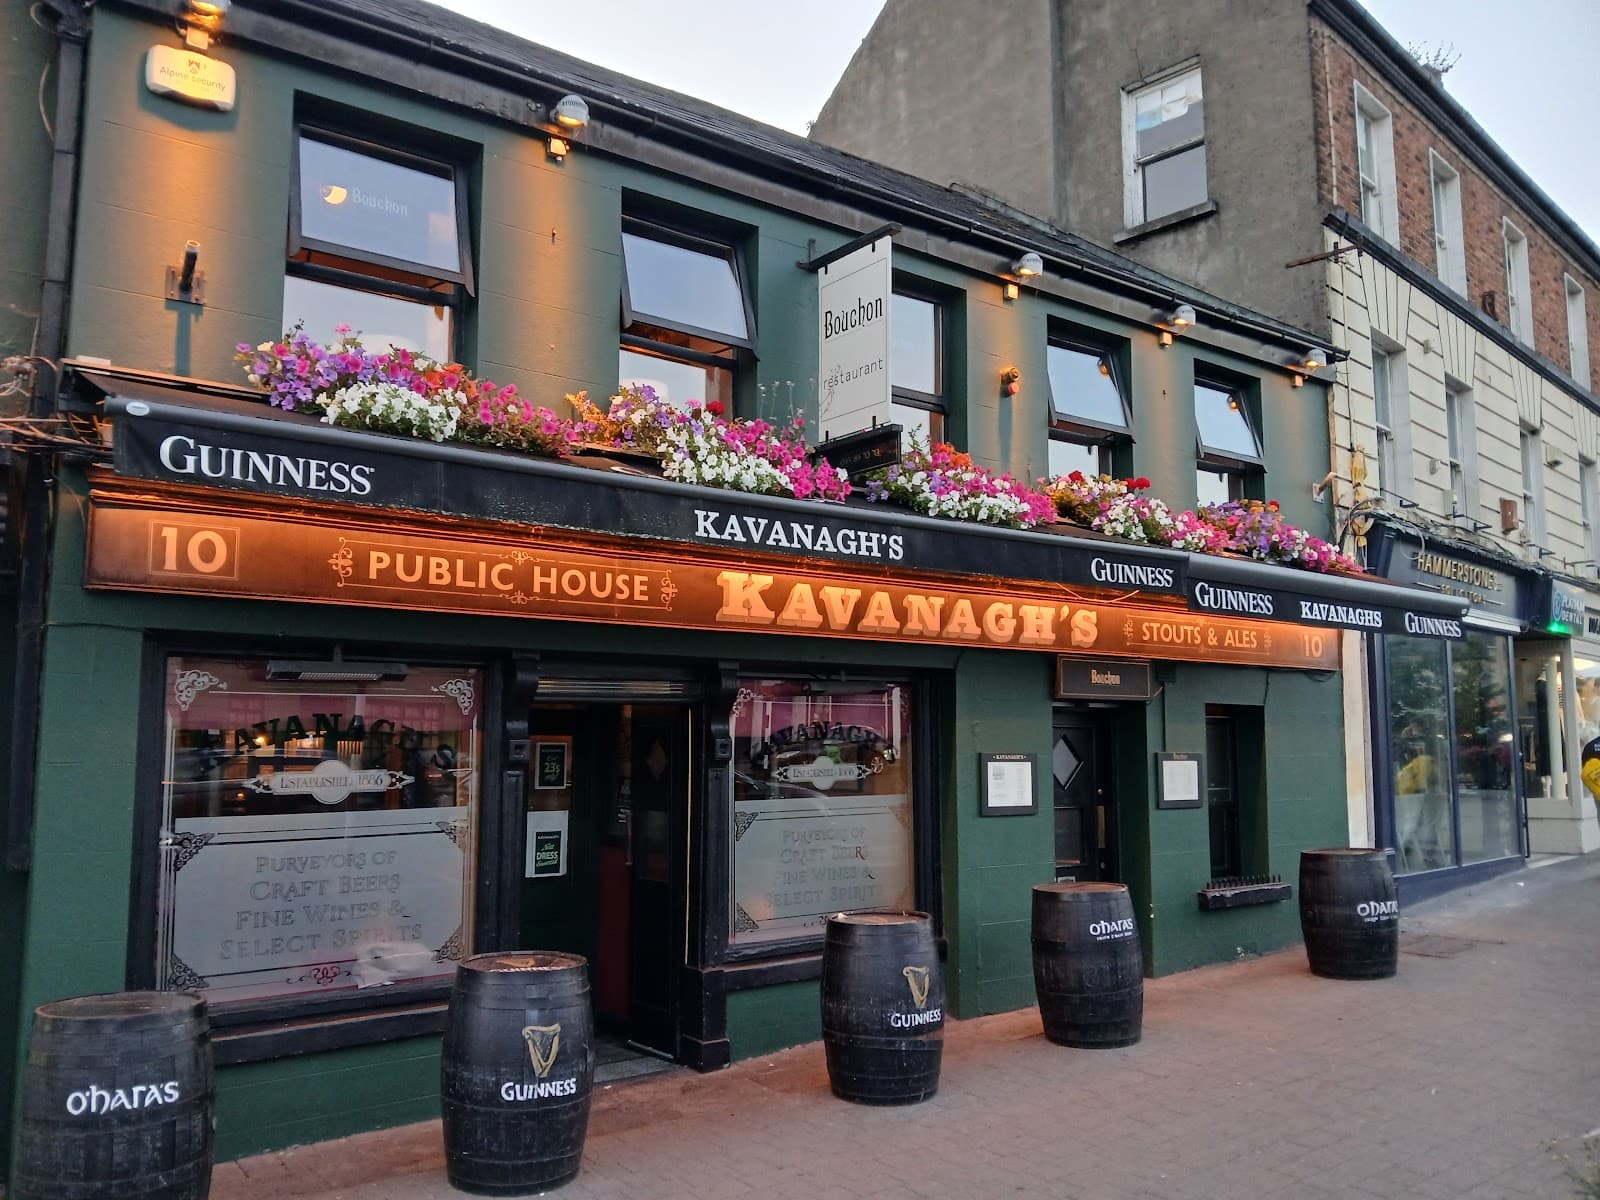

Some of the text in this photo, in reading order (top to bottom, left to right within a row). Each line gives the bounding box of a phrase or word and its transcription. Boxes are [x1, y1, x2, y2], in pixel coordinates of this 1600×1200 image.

[160, 66, 190, 80] Alpine
[351, 187, 408, 215] Bouchon
[824, 296, 884, 340] Bouchon
[823, 357, 884, 391] restaurant
[159, 434, 373, 496] GUINNESS
[694, 508, 905, 561] KAVANAGH'S
[161, 526, 228, 574] 10
[368, 550, 650, 602] PUBLIC HOUSE
[1090, 557, 1174, 589] GUINNESS
[715, 570, 1099, 649] KAVANAGH'S
[1194, 581, 1274, 616] GUINNESS
[1142, 621, 1258, 650] STOUTS & ALES
[1404, 611, 1462, 638] GUINNESS
[1303, 633, 1323, 659] 10
[255, 849, 398, 874] PURVEYORS OF
[249, 873, 401, 902] CRAFT BEERS
[234, 908, 295, 930] FINE
[303, 901, 380, 924] WINES
[219, 932, 322, 960] SELECT
[890, 1009, 941, 1028] GUINNESS
[500, 1077, 577, 1101] GUINNESS
